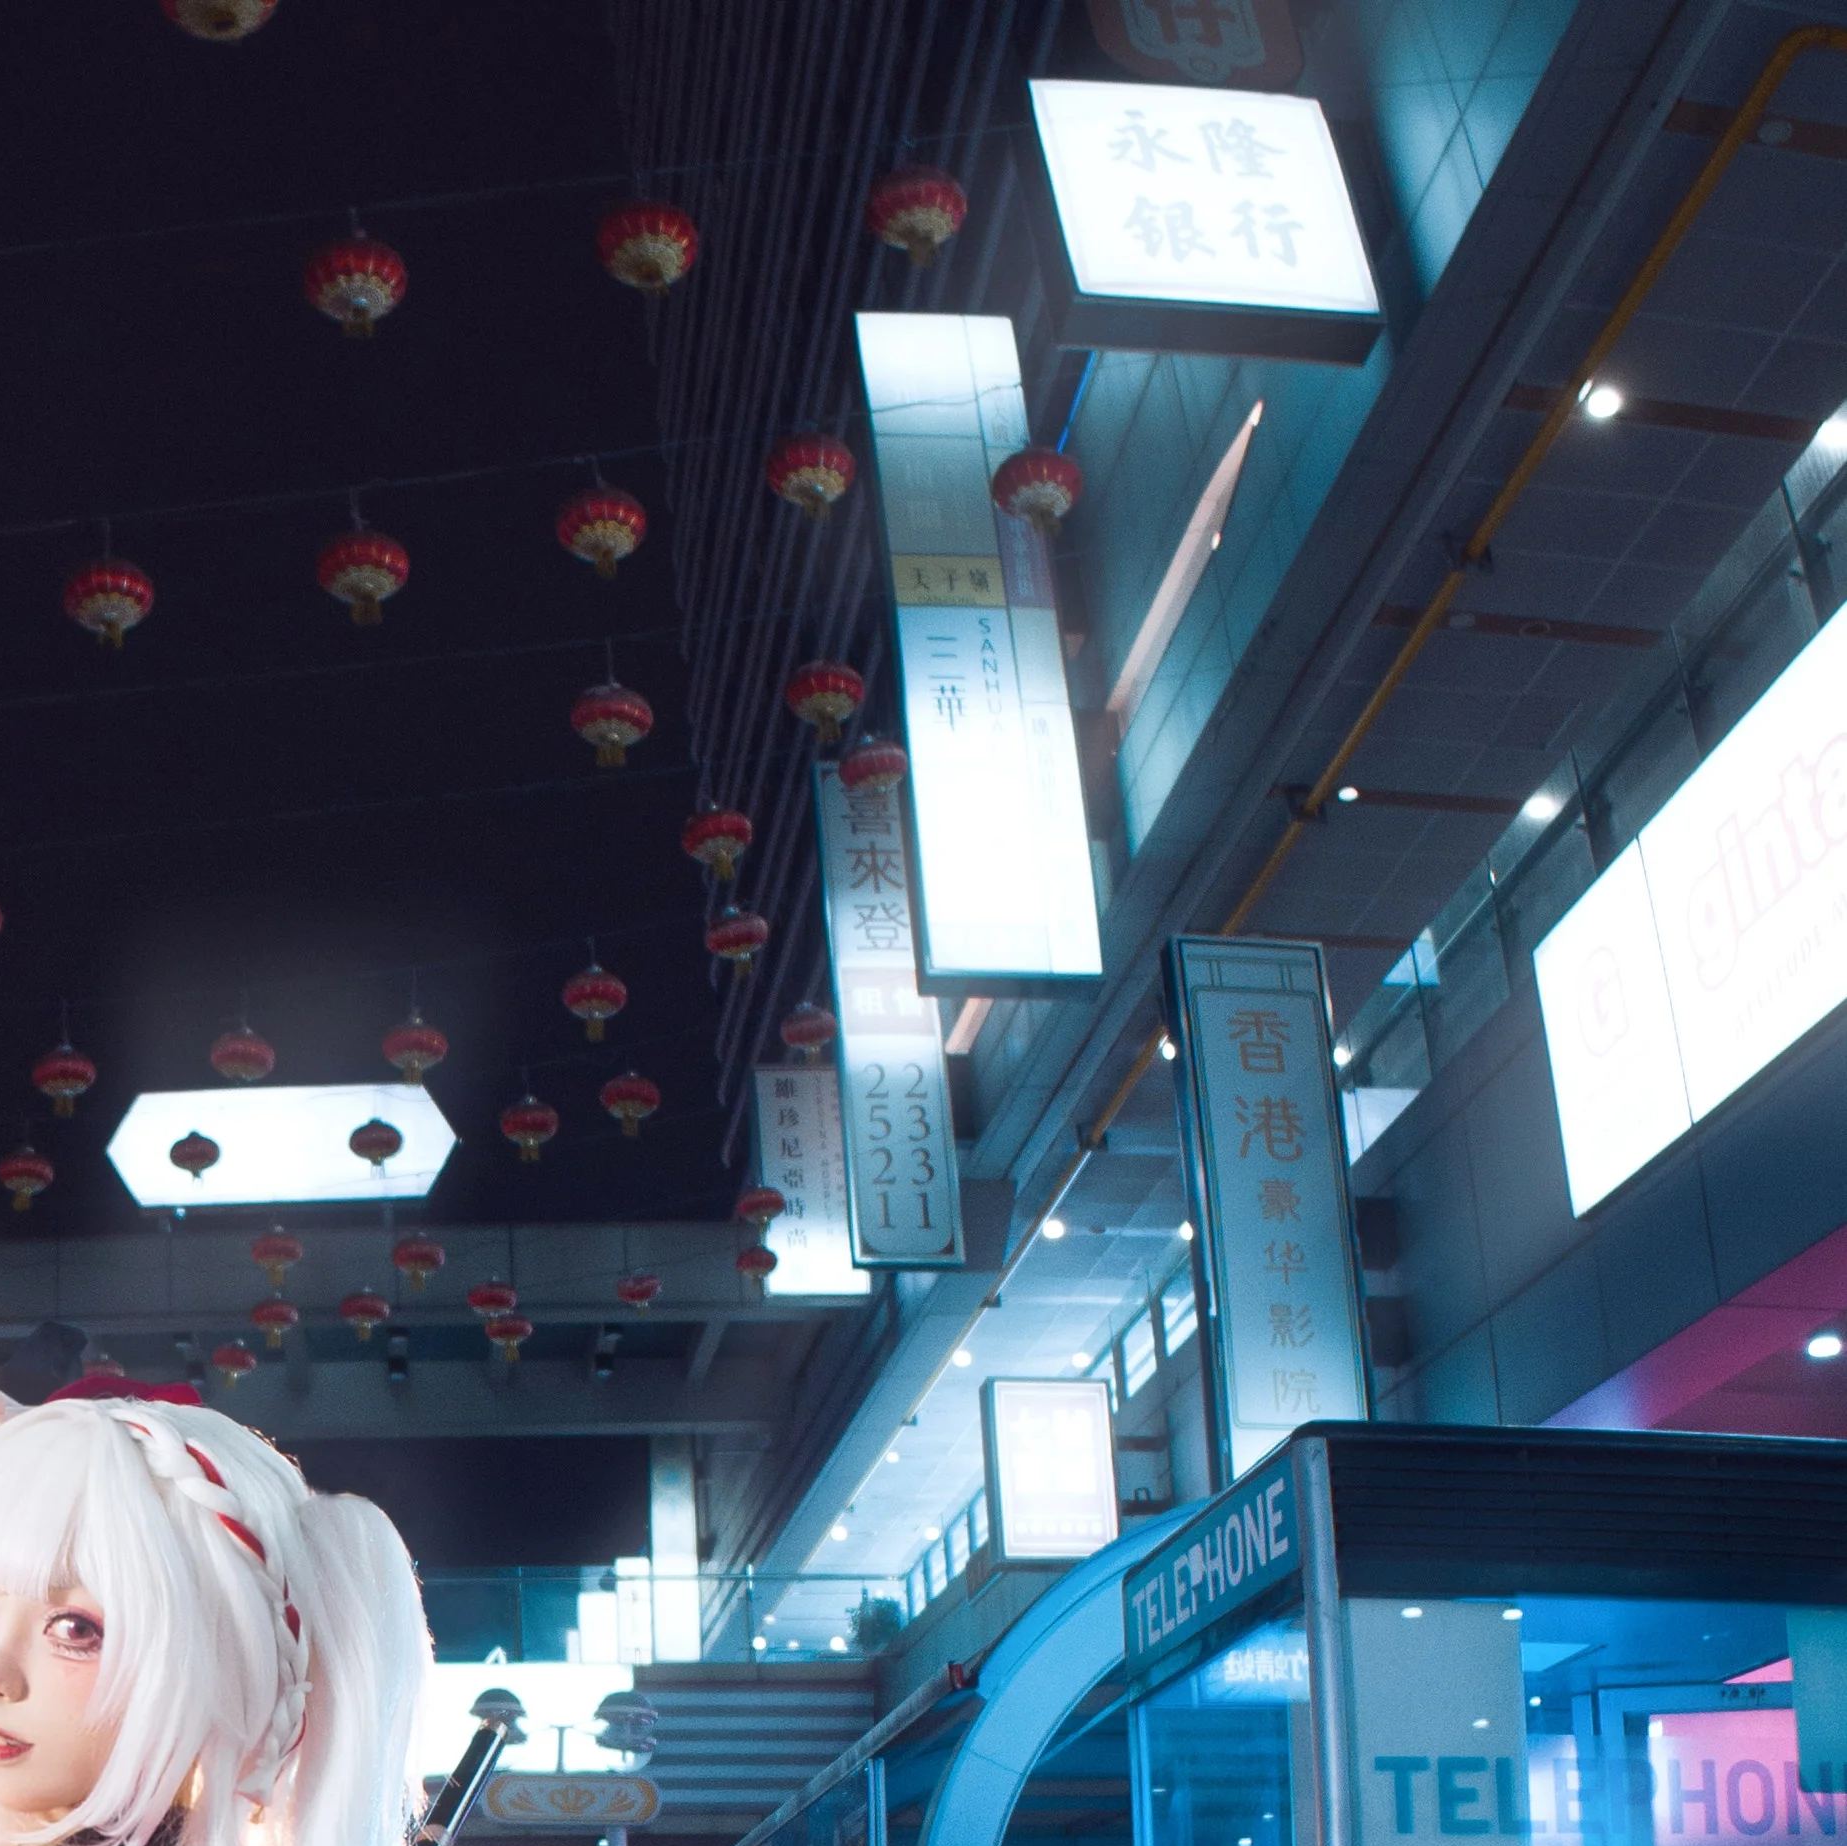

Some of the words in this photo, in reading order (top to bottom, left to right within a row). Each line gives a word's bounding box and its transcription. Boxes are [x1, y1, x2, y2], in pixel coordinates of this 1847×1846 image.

[1106, 109, 1285, 181] 永隆
[1124, 196, 1305, 270] 銀行
[1228, 1008, 1322, 1416] 香港豪华影院
[1132, 1477, 1289, 1655] TELEPHONE
[1374, 1756, 1847, 1837] TELEPHON
